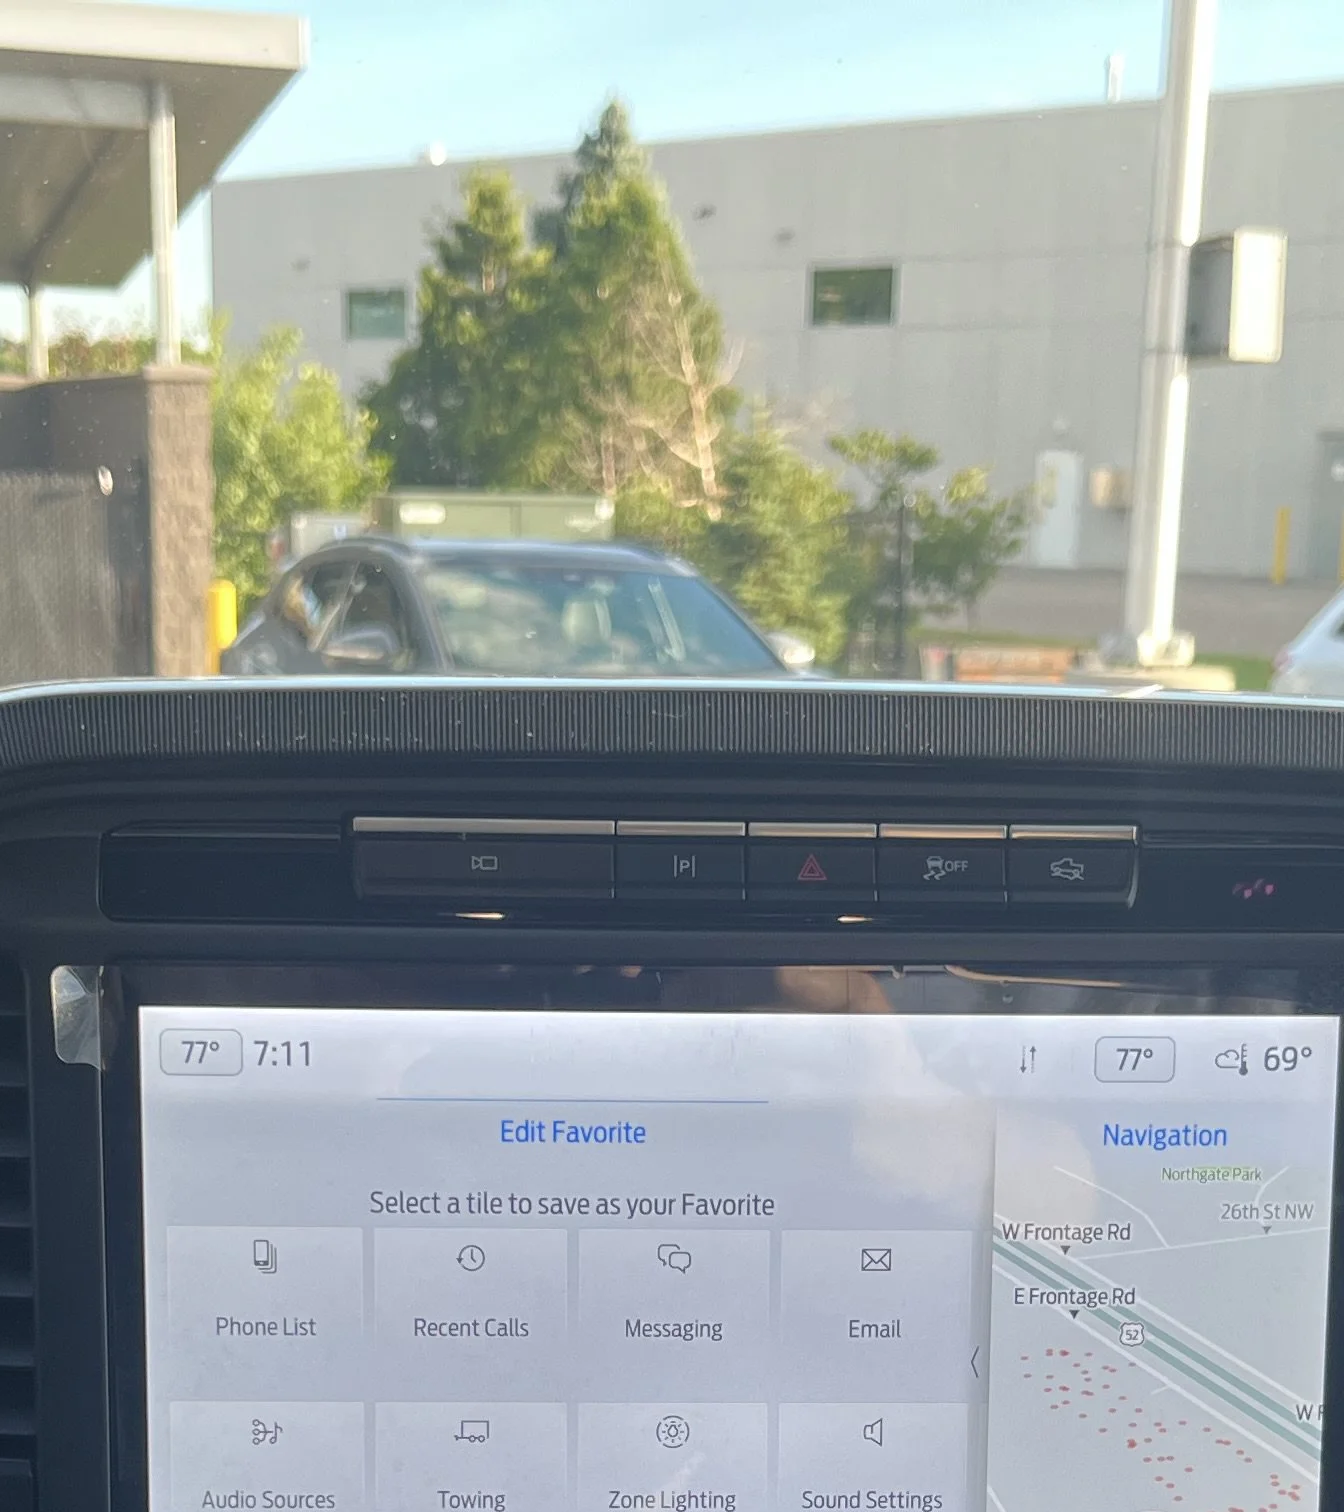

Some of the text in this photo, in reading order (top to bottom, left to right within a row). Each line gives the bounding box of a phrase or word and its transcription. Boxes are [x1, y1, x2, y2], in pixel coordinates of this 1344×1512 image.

[944, 860, 969, 872] OFF
[180, 1039, 221, 1065] 77°
[253, 1040, 312, 1067] 7:11
[1115, 1047, 1154, 1072] 77°
[1262, 1046, 1313, 1073] 69°
[500, 1119, 647, 1144] Edit Favorite
[1103, 1122, 1228, 1152] Navigation
[1161, 1167, 1262, 1185] Northgate Park
[370, 1190, 775, 1220] Select a tile to save as your Favorite
[1220, 1203, 1314, 1221] 26th St NW
[1002, 1222, 1131, 1247] W Frontage Rd
[1014, 1287, 1136, 1311] E Frontage Rd
[216, 1316, 317, 1338] Phone List
[413, 1317, 529, 1338] Recent Calls
[624, 1318, 723, 1343] Messaging
[848, 1318, 902, 1340] Email
[1124, 1327, 1140, 1343] 52
[1296, 1404, 1313, 1421] W
[202, 1490, 335, 1510] Audio Sources
[608, 1491, 655, 1511] Zone
[801, 1490, 861, 1510] Sound
